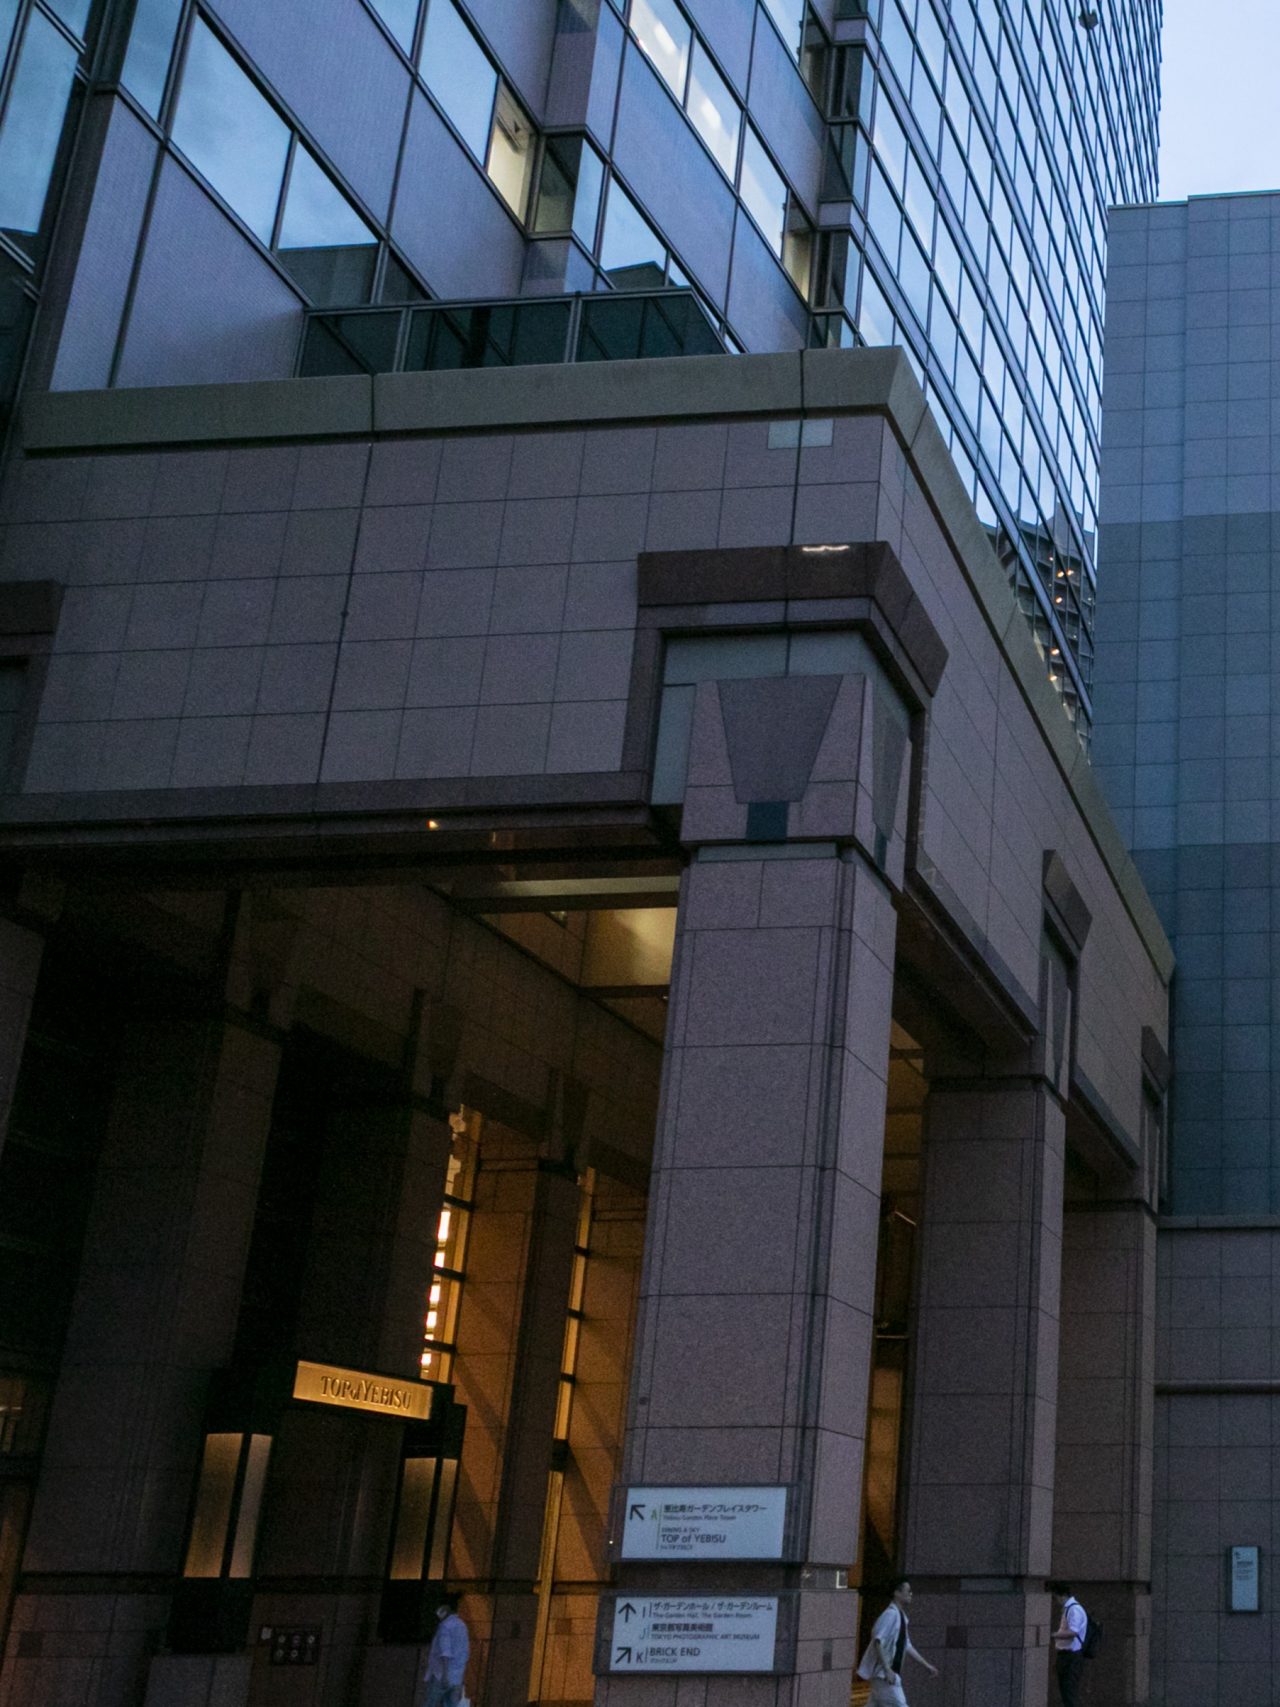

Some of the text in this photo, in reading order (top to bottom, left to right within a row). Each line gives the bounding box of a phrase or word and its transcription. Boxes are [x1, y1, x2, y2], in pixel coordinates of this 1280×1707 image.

[662, 1534, 726, 1542] TOP of YEBISU
[650, 1648, 700, 1656] BRICK END
[636, 1652, 644, 1664] K
